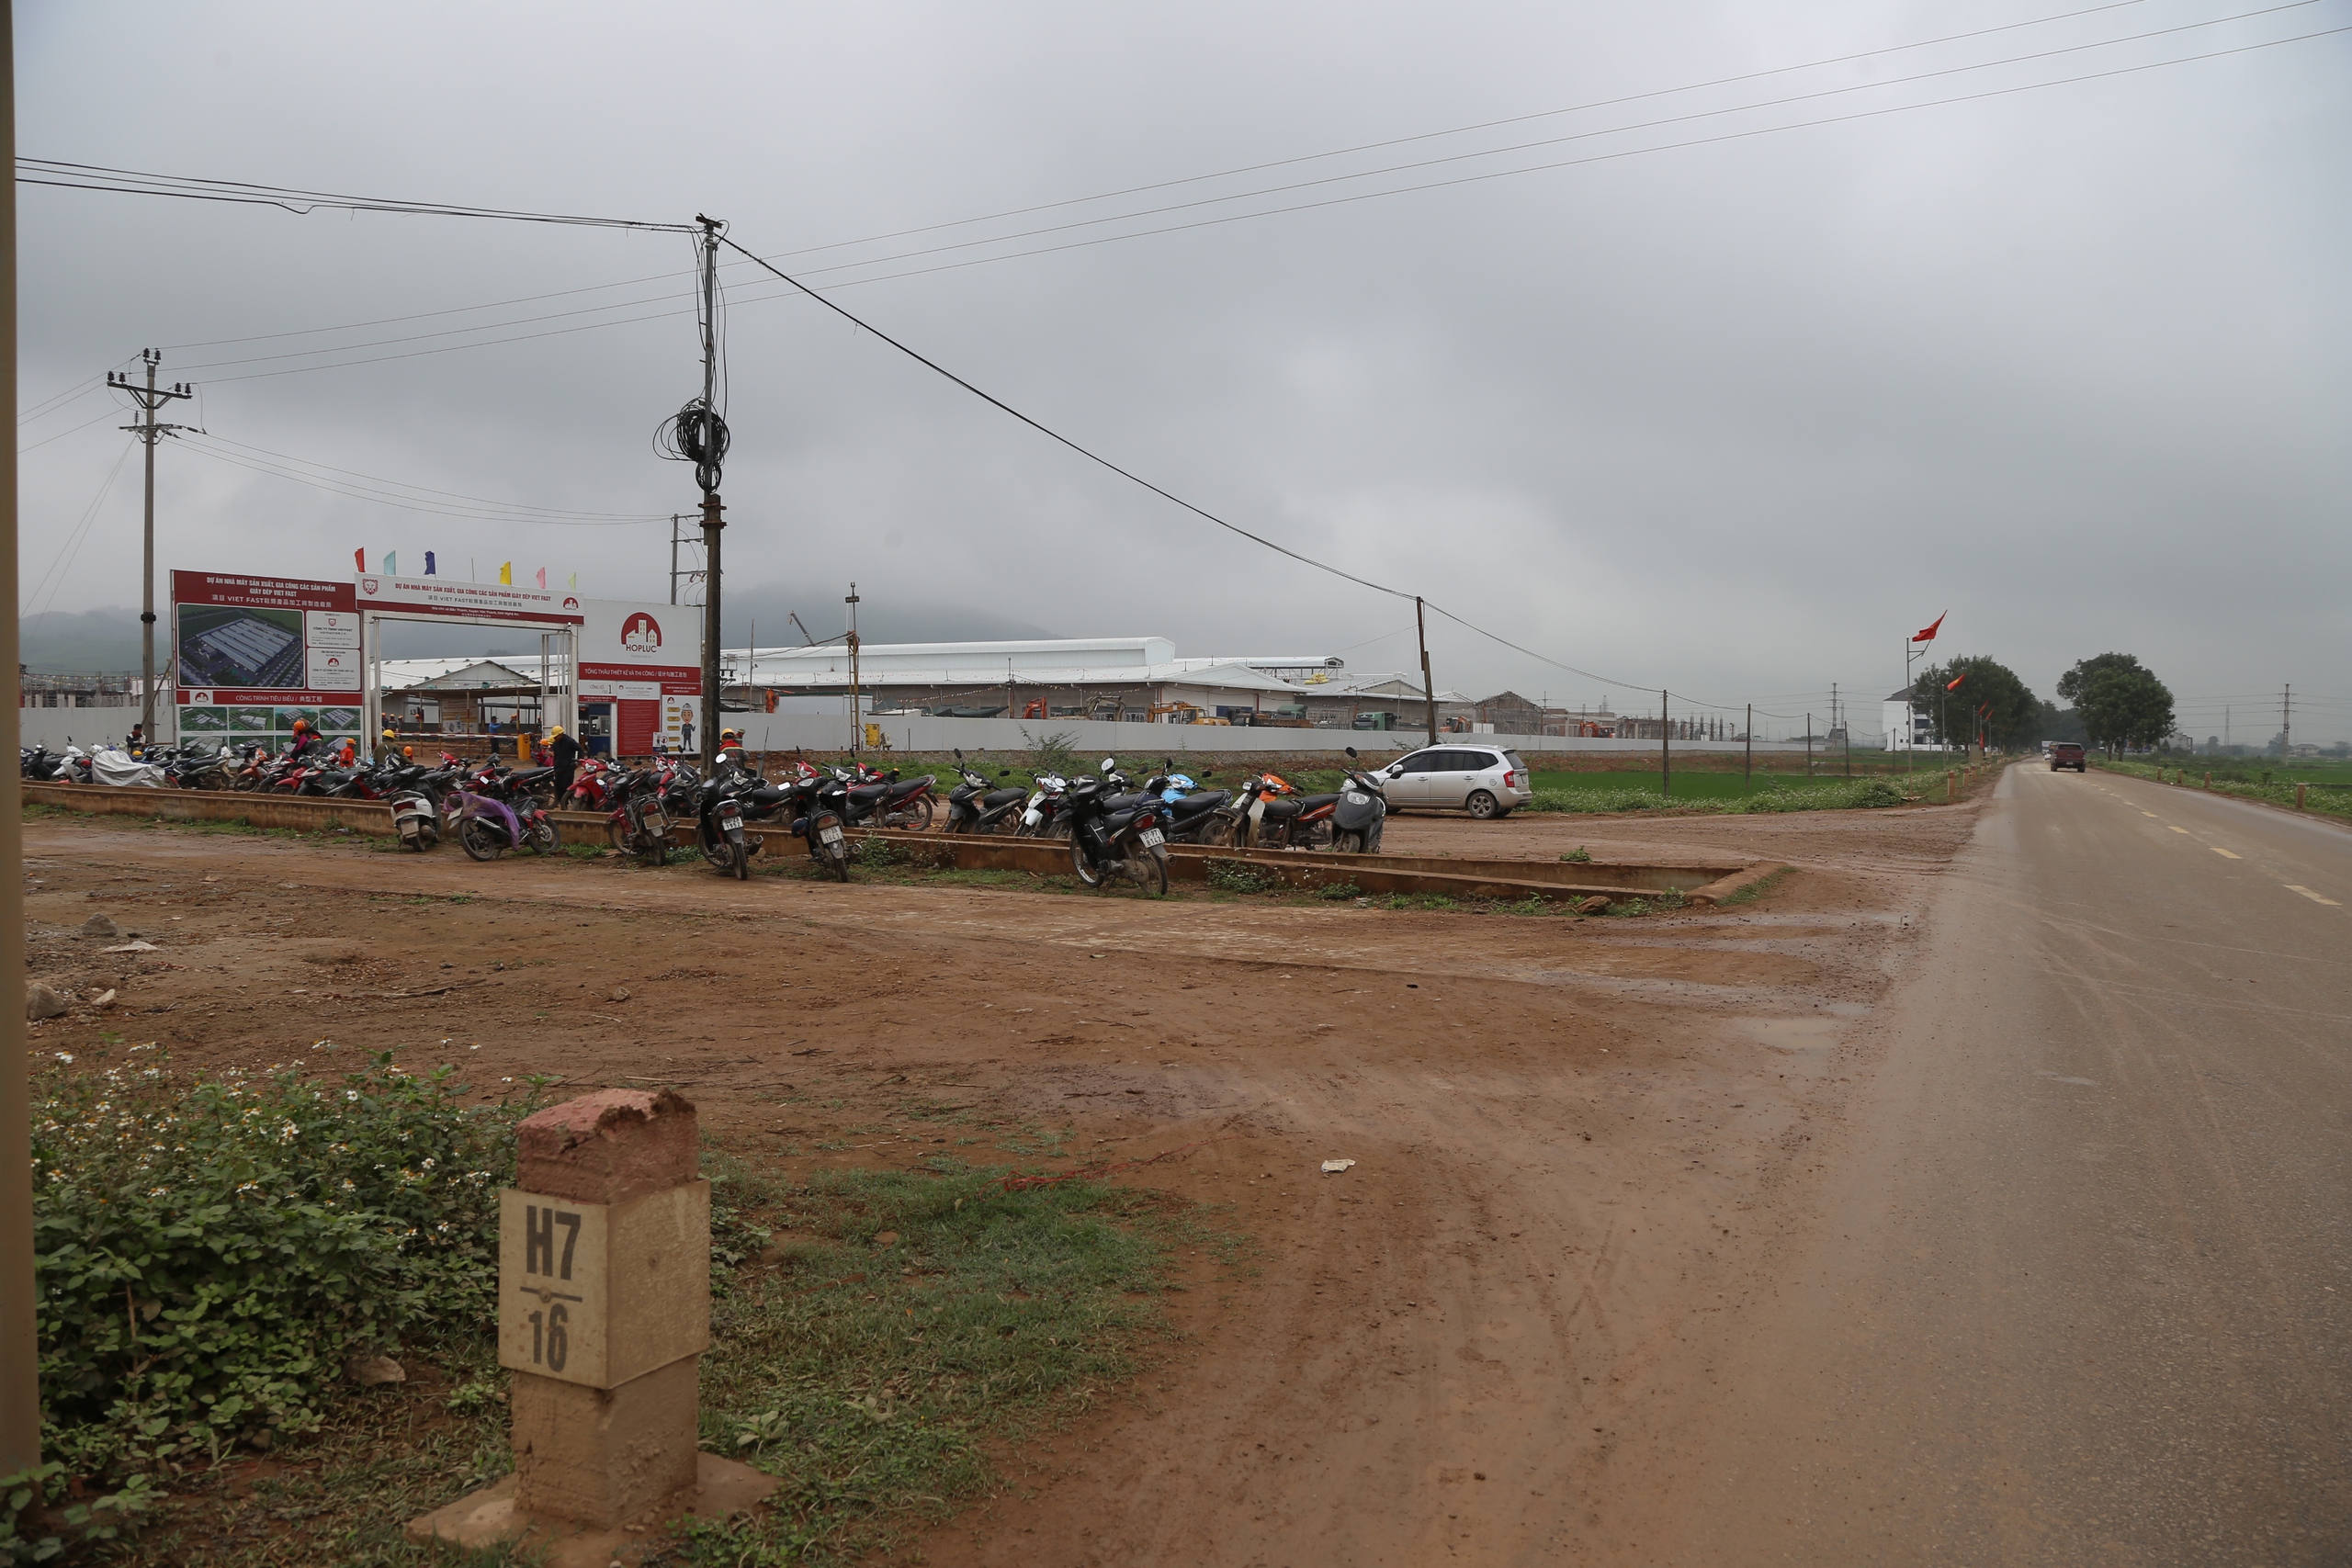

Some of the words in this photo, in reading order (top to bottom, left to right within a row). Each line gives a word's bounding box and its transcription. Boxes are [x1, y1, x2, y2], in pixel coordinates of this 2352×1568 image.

[236, 578, 248, 586] MÁY
[285, 581, 299, 590] CÔNG
[300, 582, 310, 591] CÁC
[626, 644, 657, 653] HOPLUC
[526, 1205, 582, 1280] H7
[528, 1303, 568, 1372] 16
